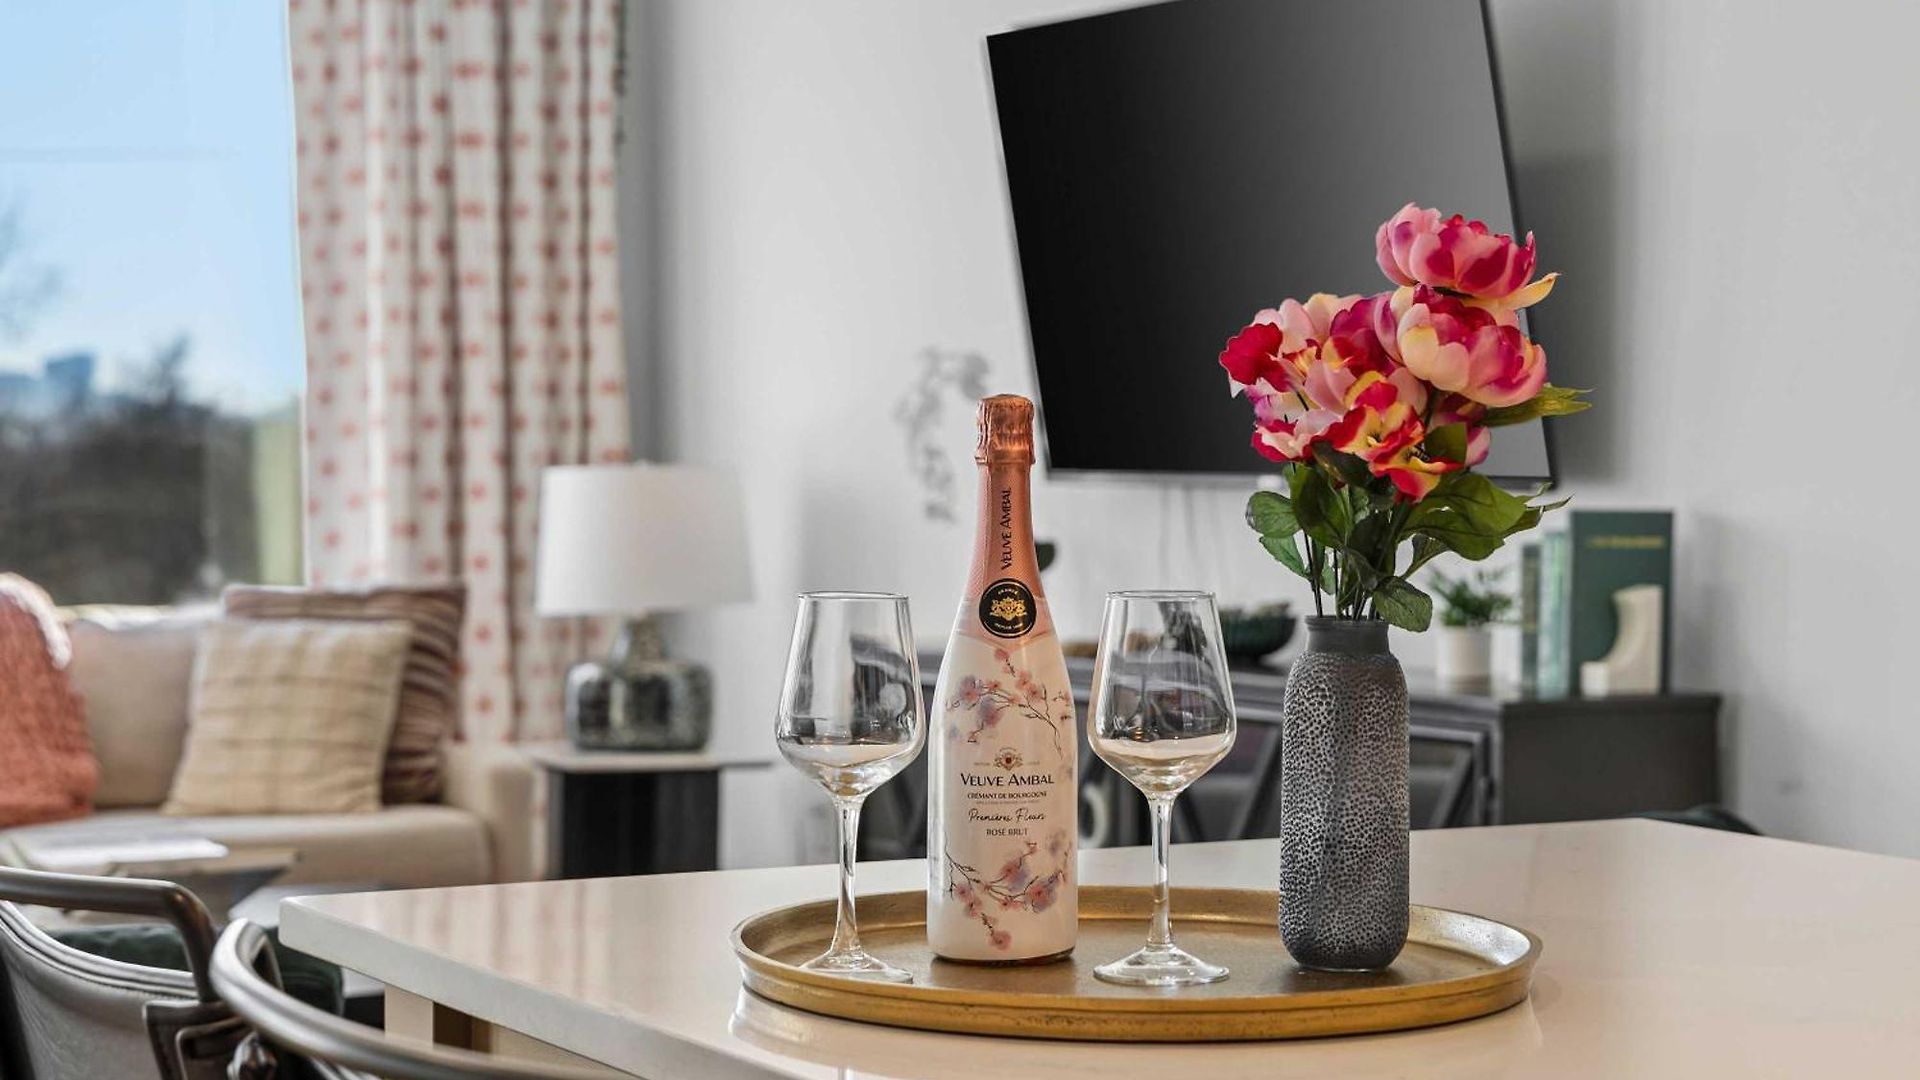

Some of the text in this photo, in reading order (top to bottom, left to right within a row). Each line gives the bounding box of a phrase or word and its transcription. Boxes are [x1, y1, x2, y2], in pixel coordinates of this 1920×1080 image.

[999, 487, 1012, 570] VEUVE AMBAL
[960, 773, 1055, 786] VEUVE AMBAL
[1008, 791, 1047, 799] BOURGOGNE
[1008, 828, 1028, 836] BRUT
